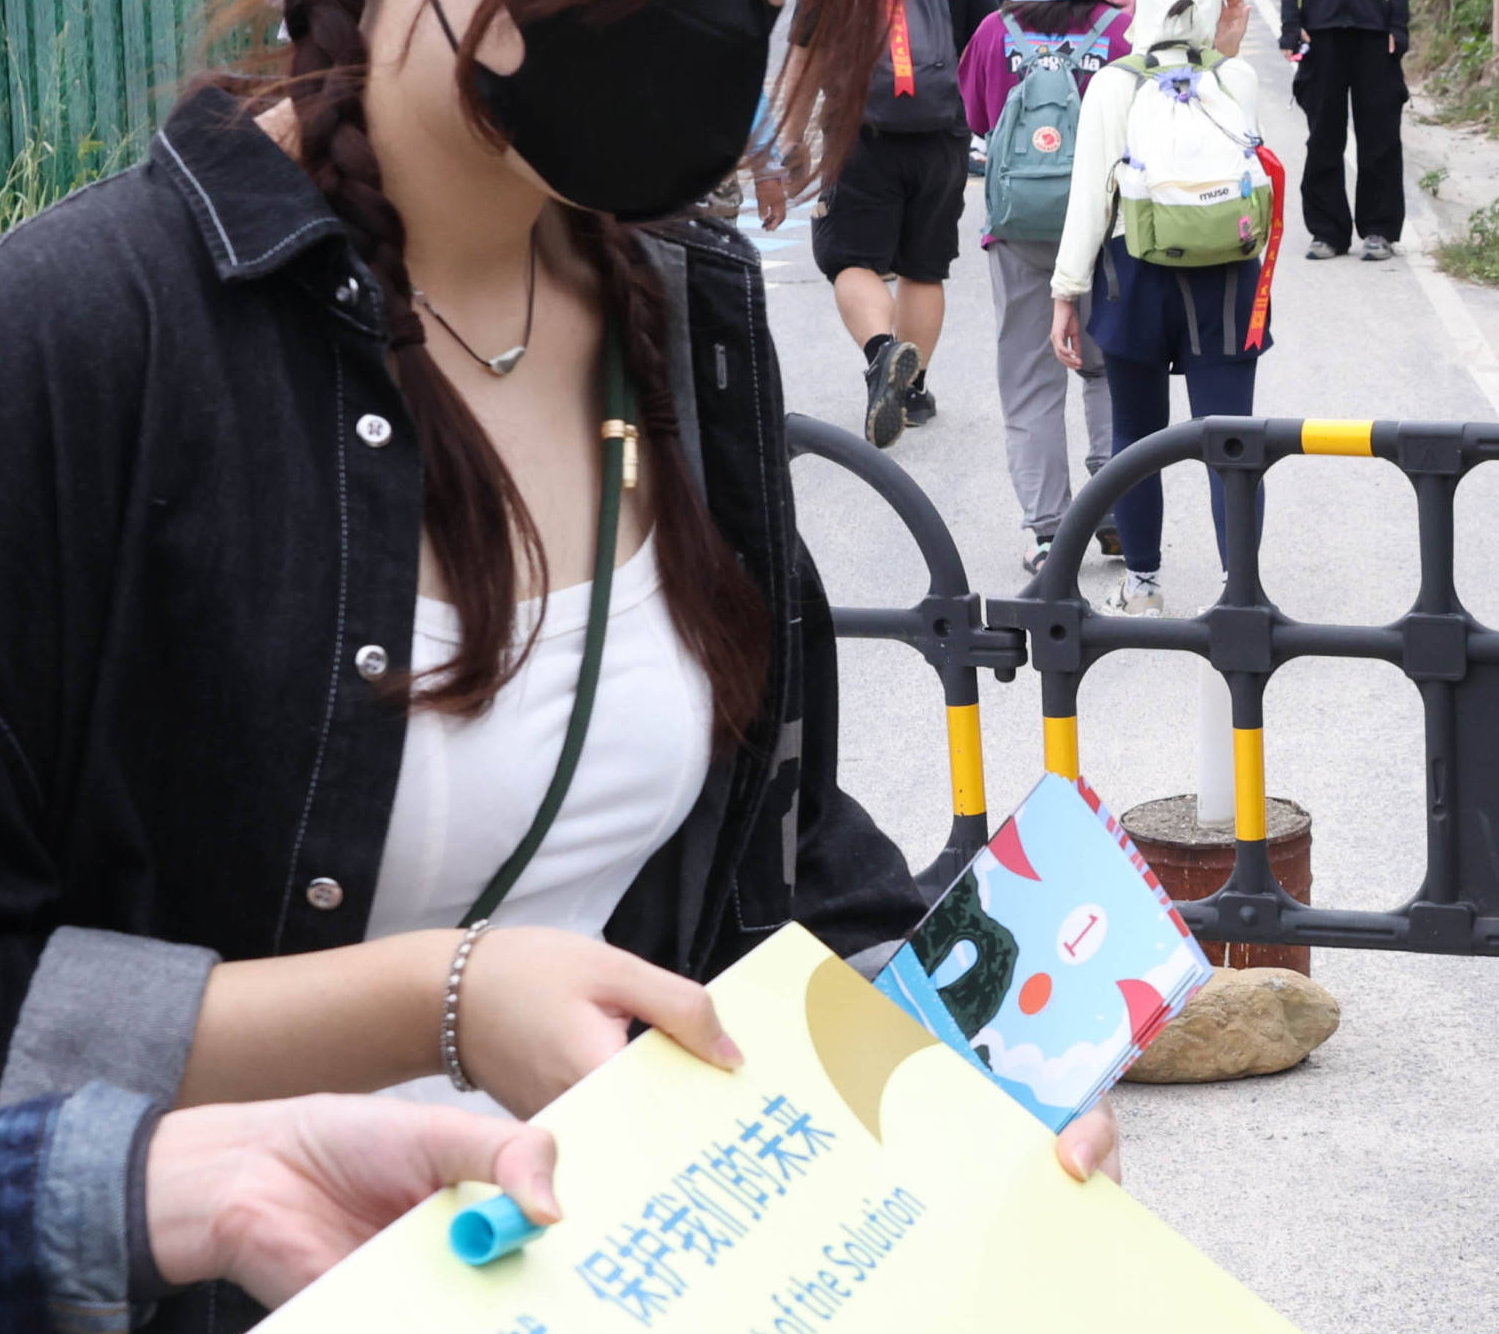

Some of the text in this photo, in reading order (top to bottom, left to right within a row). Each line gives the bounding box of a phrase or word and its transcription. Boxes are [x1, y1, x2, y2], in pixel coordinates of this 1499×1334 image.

[1199, 186, 1229, 201] muse
[788, 1269, 853, 1322] the
[822, 1186, 928, 1283] Solution
